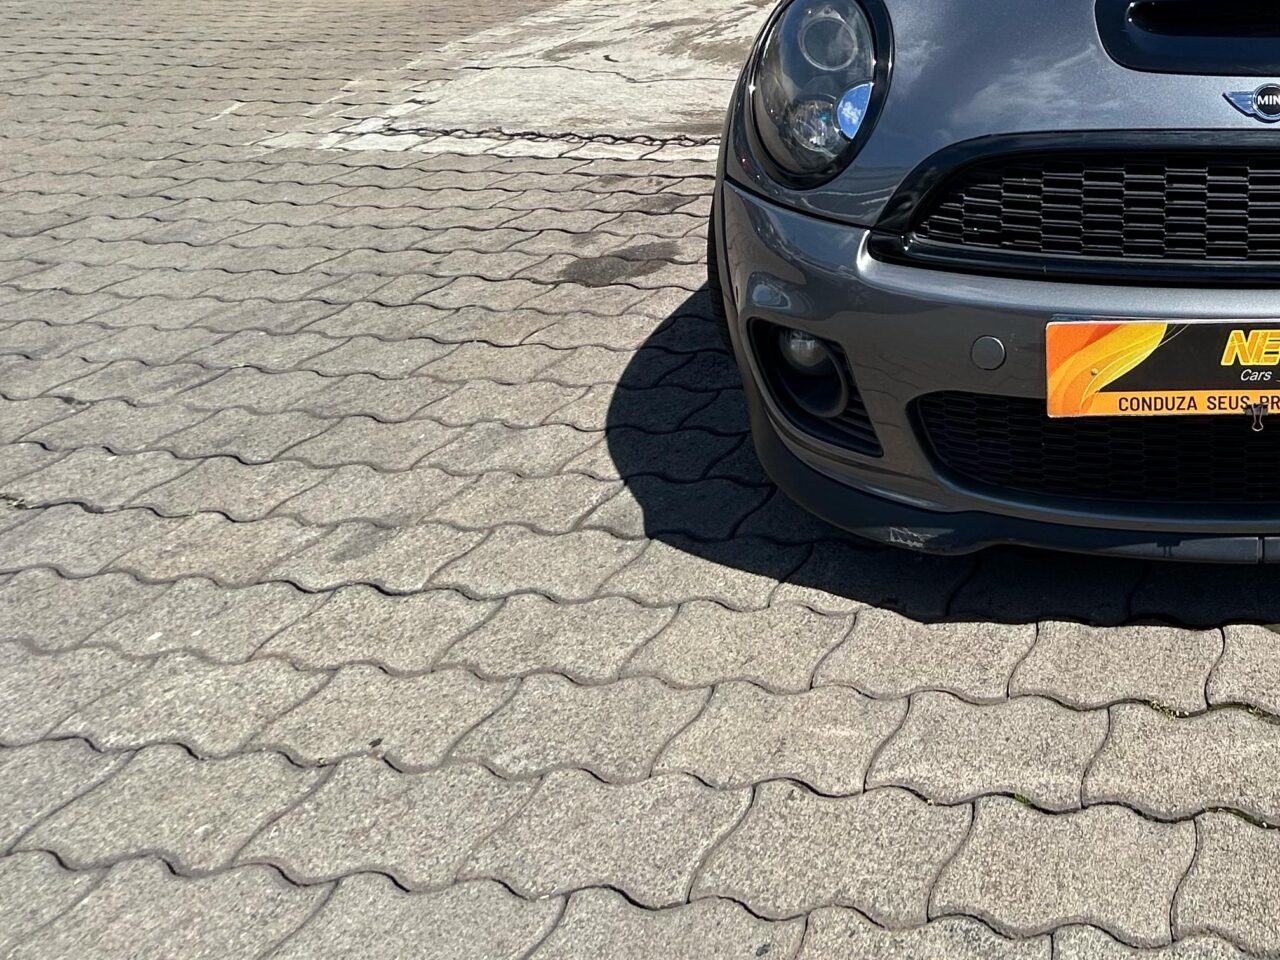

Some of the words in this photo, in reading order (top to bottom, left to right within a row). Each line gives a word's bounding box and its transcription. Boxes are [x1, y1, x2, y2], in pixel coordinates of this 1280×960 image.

[1240, 368, 1273, 381] Cars
[1118, 396, 1198, 412] CONDUZA
[1206, 395, 1251, 411] SEUS
